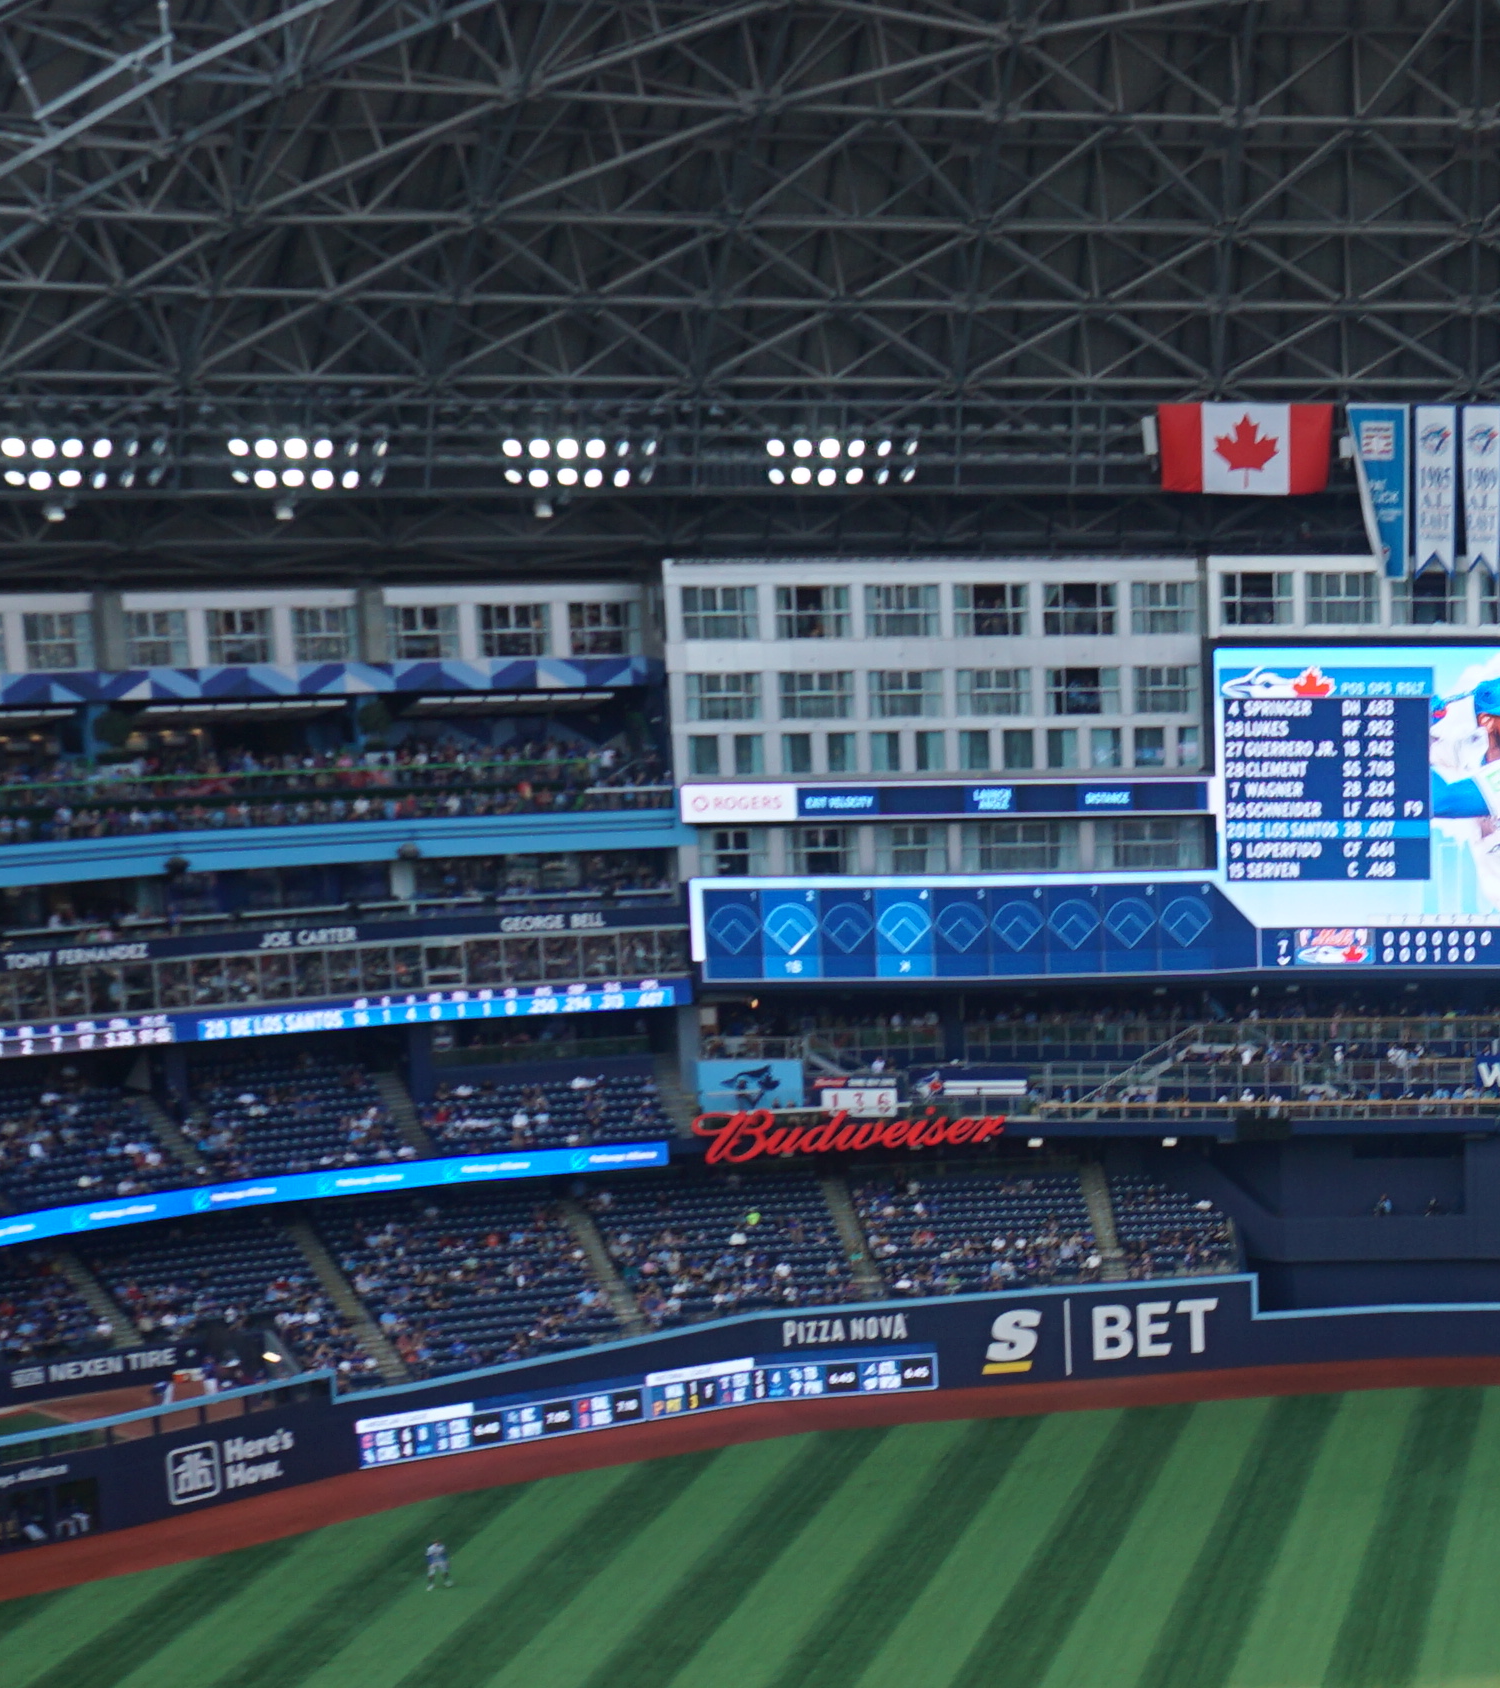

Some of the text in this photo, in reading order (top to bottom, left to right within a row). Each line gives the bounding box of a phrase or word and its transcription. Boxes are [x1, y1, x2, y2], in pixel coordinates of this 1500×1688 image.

[1243, 700, 1312, 717] SPRINGER
[1244, 720, 1289, 737] LUKES
[1244, 741, 1338, 757] GUERRERO JR.
[1245, 761, 1309, 778] CLEMENT
[1245, 781, 1304, 798] WAGNER
[1245, 801, 1322, 818] SCHNEIDER
[1245, 821, 1339, 838] DE LOS SANTOS
[1246, 842, 1322, 859] LOPERFIDO
[1246, 862, 1300, 879] SERVEN
[501, 912, 607, 932] GEORGE BELL
[260, 926, 357, 949] JOE CARTER
[5, 943, 149, 970] TONY FERNANDEZ
[691, 1106, 1006, 1165] Budweiser
[783, 1313, 908, 1347] PIZZA NOVA
[985, 1296, 1219, 1363] S BET
[49, 1358, 126, 1383] NEXEN
[127, 1347, 177, 1369] TIRE
[223, 1428, 294, 1463] Here's
[18, 1463, 69, 1483] Alliance
[225, 1460, 284, 1490] How.
